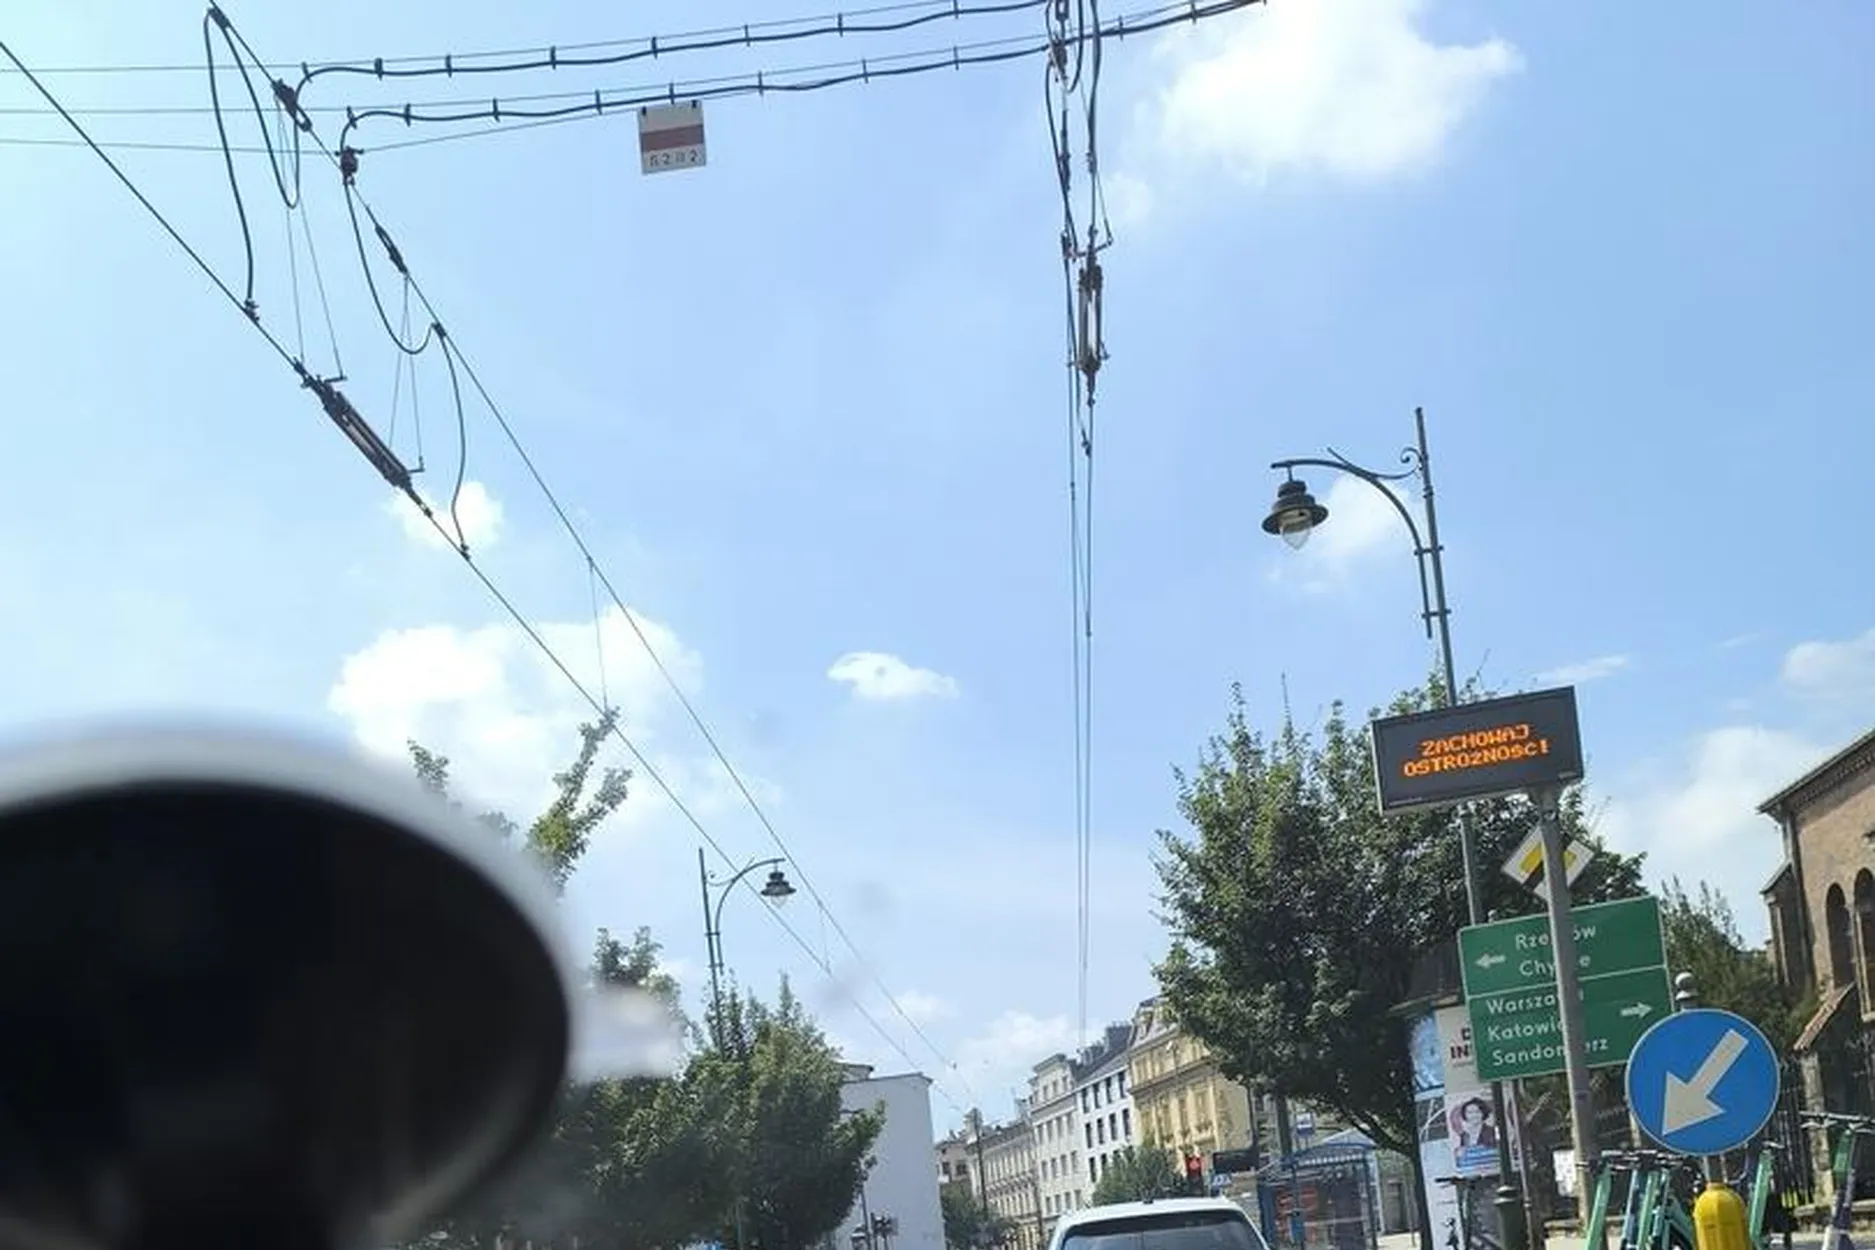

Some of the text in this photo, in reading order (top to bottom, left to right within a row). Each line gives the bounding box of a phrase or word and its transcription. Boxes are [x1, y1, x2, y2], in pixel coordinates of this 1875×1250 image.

[1421, 723, 1530, 757] ZACHOWAJ
[1514, 925, 1596, 951] Rzeów
[1519, 955, 1591, 979] Chye
[1486, 987, 1584, 1015] Warsza
